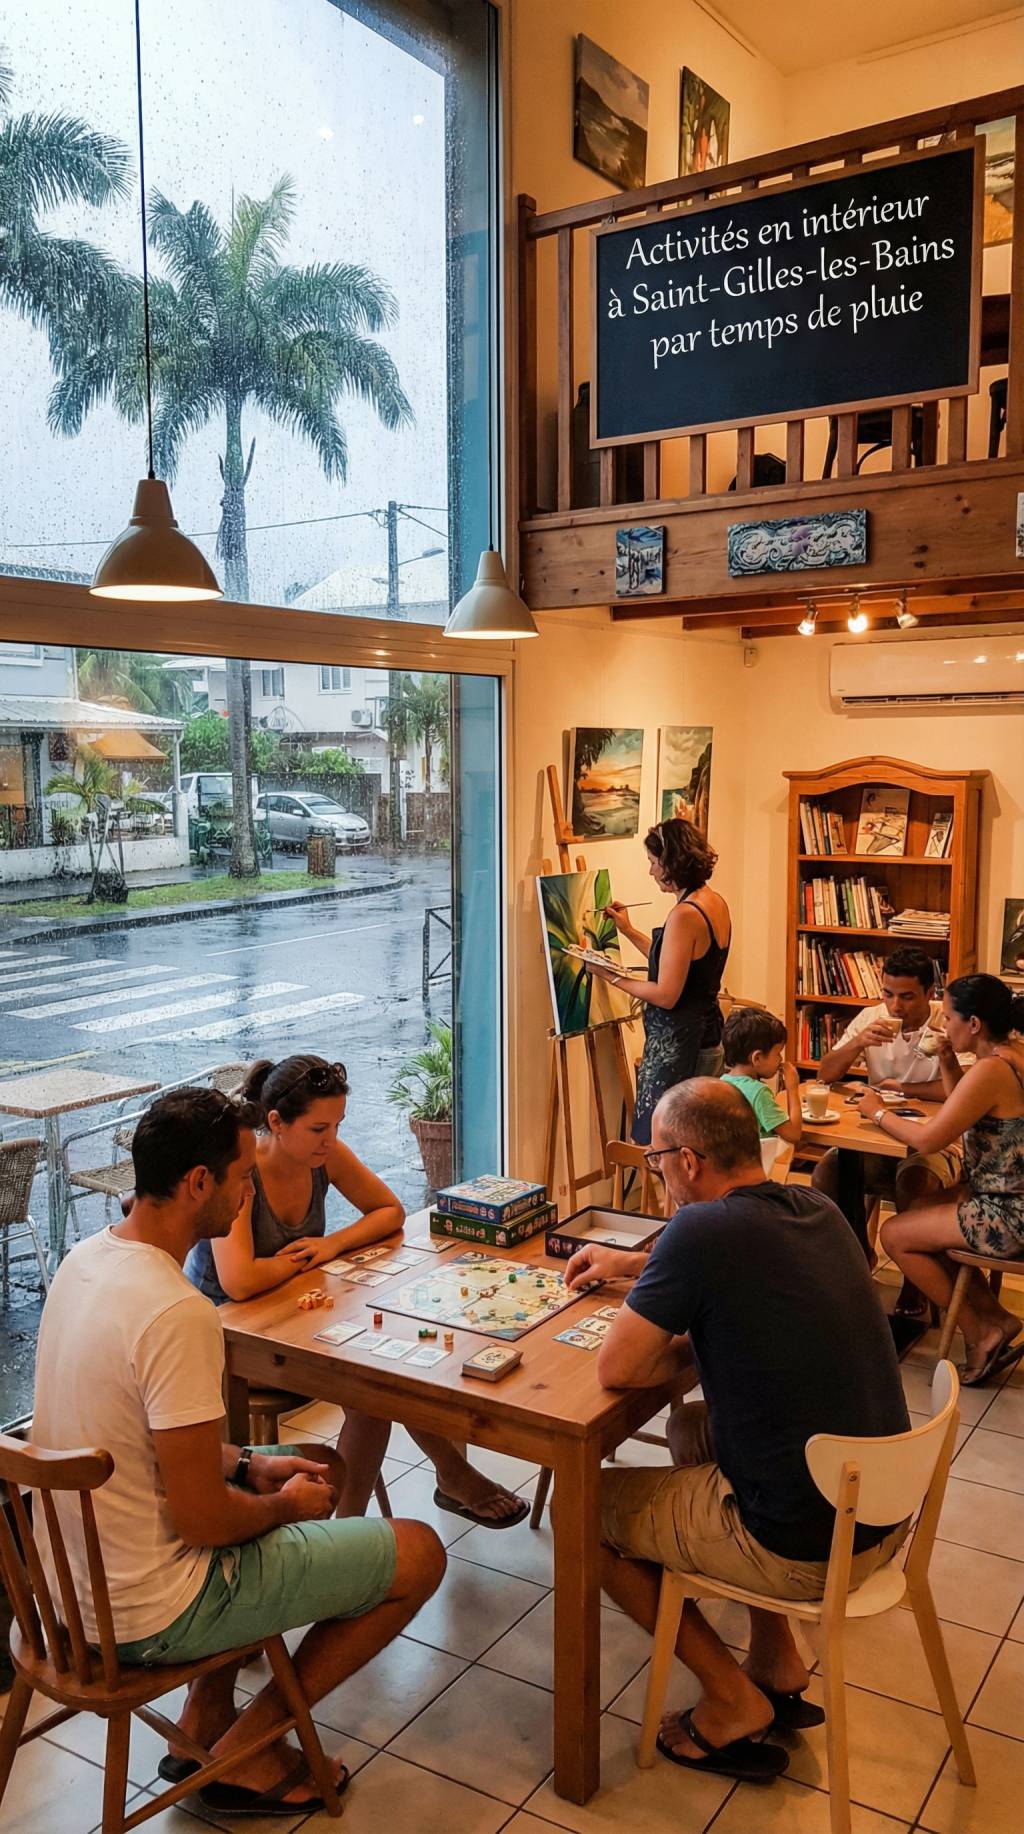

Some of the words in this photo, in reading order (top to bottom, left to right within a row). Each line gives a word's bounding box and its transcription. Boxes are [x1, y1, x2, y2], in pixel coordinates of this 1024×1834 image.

[625, 219, 749, 270] Activités
[758, 221, 794, 245] en
[802, 195, 930, 238] intérieur
[607, 288, 627, 319] à
[632, 237, 955, 315] Saint-Gilles-les-Bains
[649, 330, 702, 370] par
[708, 313, 799, 349] temps
[807, 293, 842, 330] de
[848, 284, 924, 334] pluie
